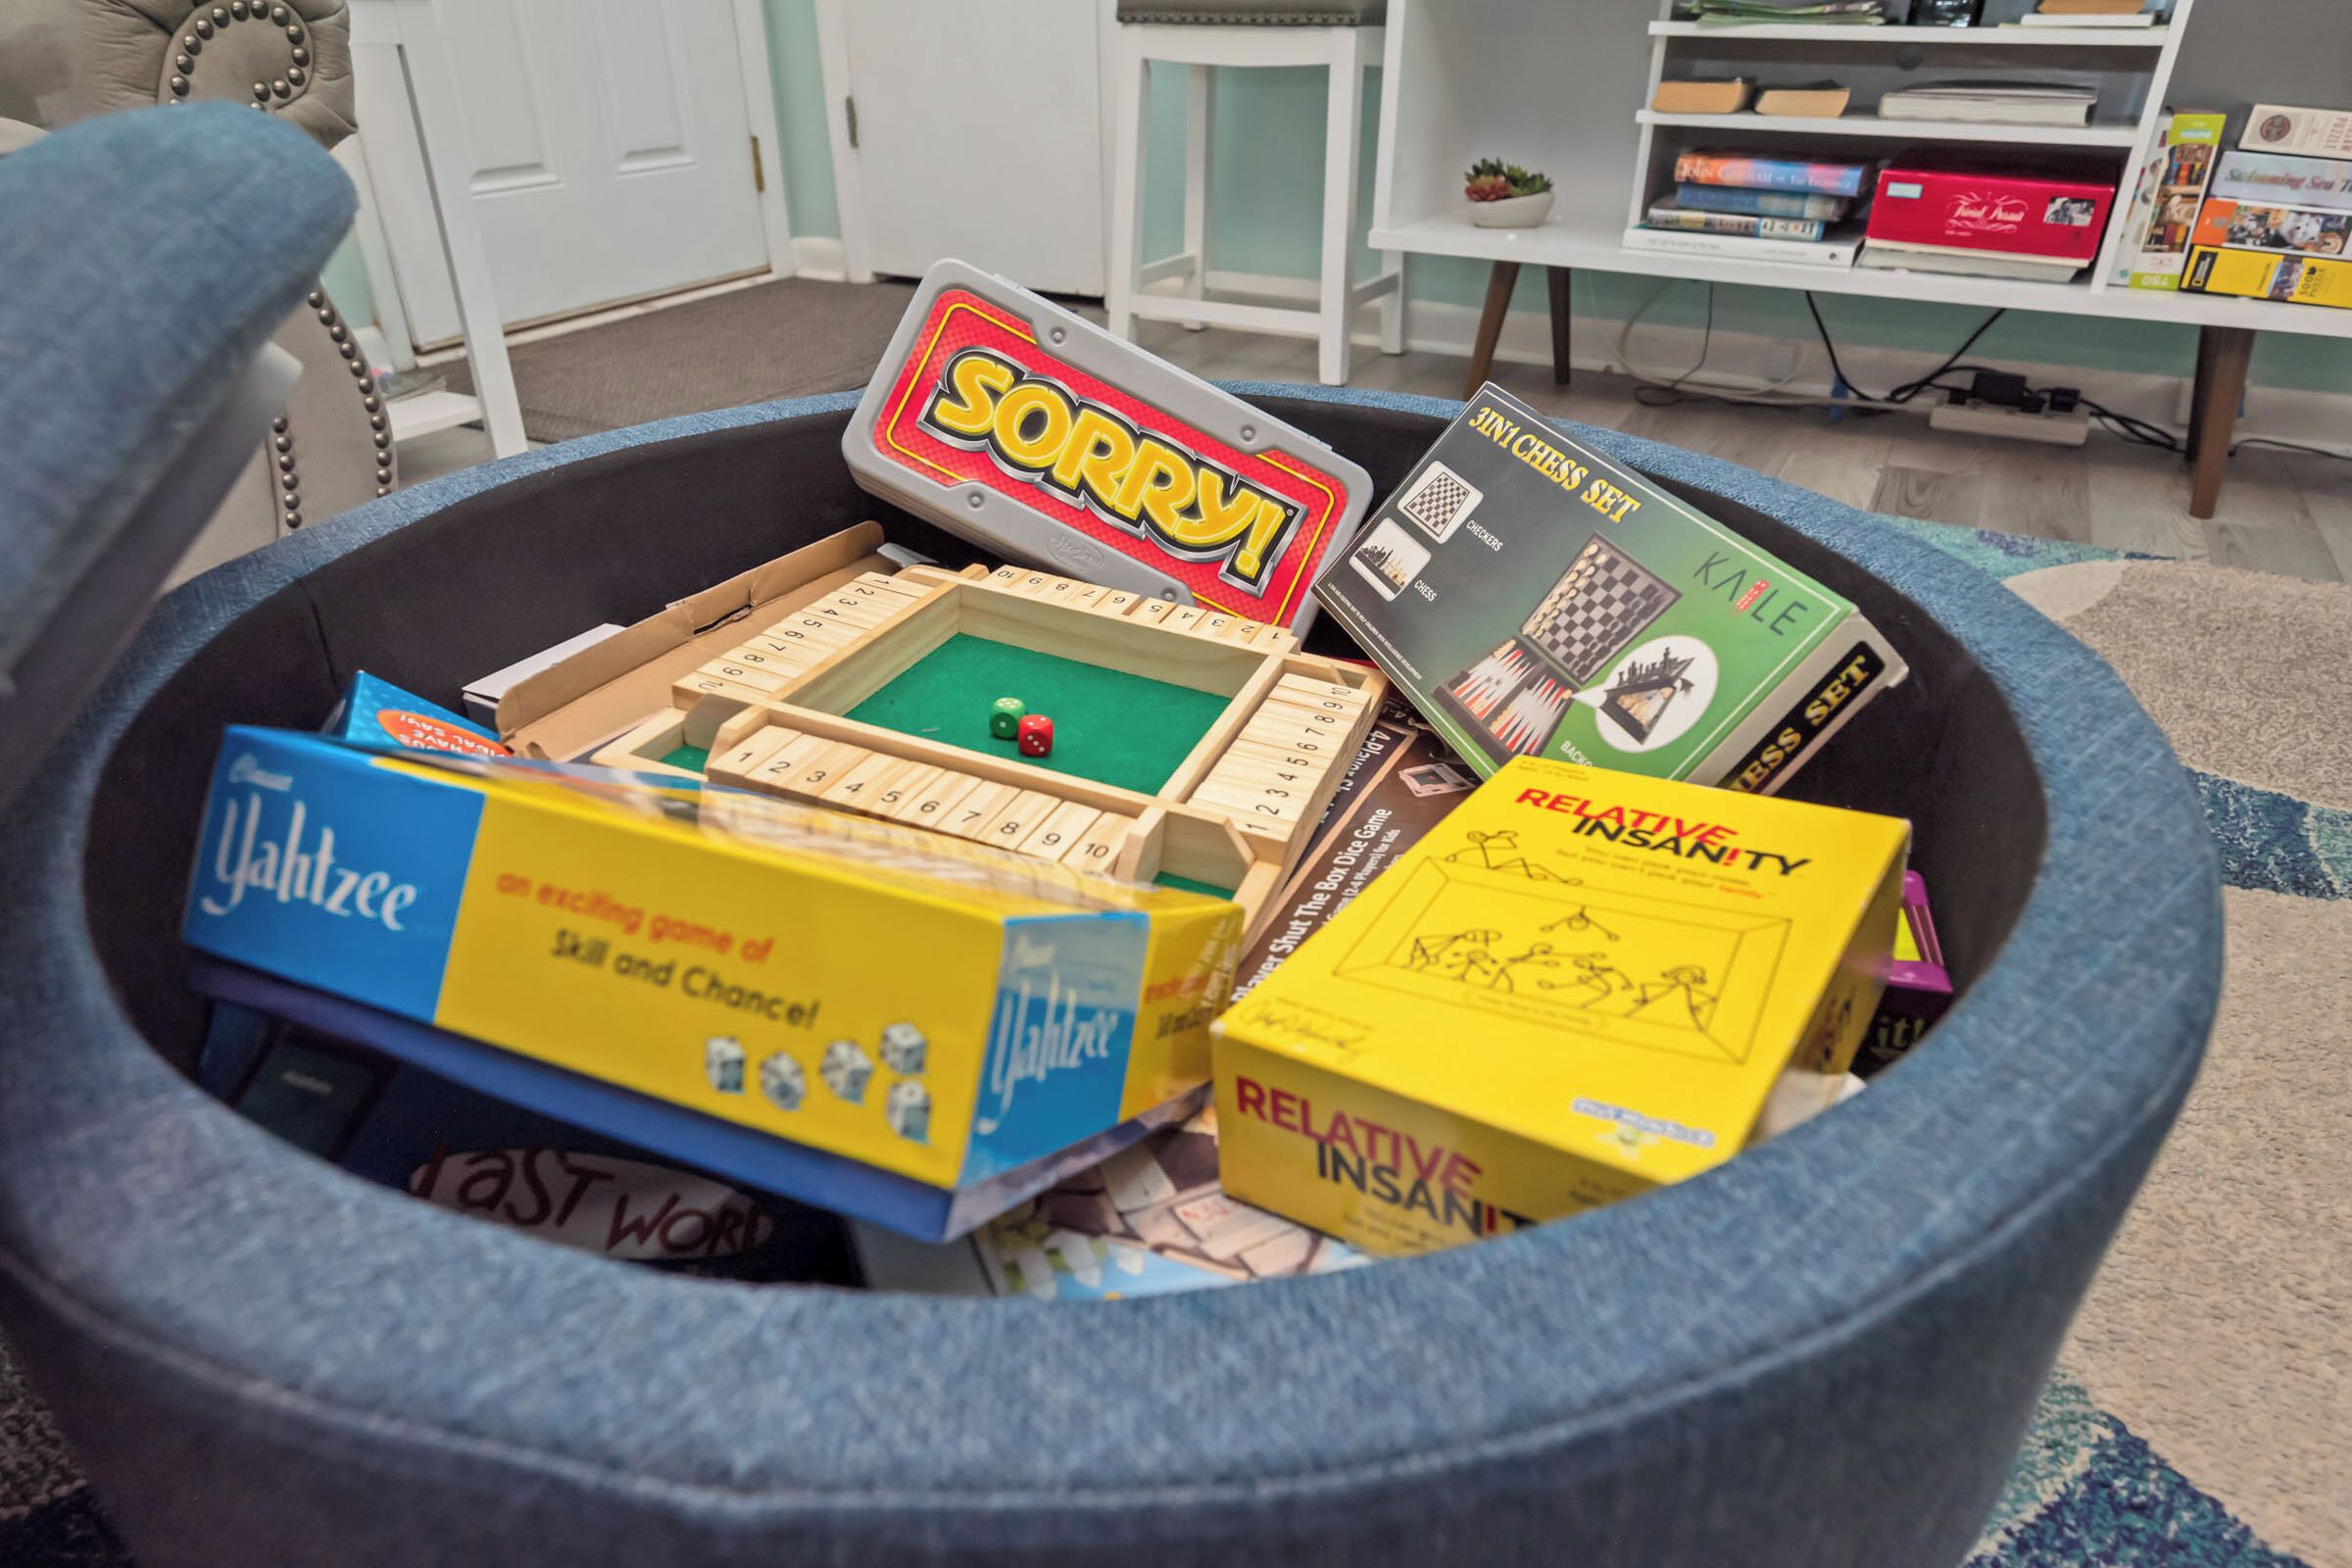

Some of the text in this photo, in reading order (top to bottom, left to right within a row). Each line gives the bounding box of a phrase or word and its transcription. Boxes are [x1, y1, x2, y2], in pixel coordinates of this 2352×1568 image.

[934, 355, 1286, 579] SORRY!
[1510, 431, 1590, 492] CHESS
[1580, 480, 1642, 525] SET
[1465, 518, 1504, 553] CHECKERS
[997, 569, 1015, 579] 10
[1413, 578, 1438, 602] CHESS
[721, 667, 744, 676] 9
[744, 654, 764, 662] 8
[699, 680, 724, 690] 10
[1330, 687, 1351, 697] 10
[1305, 727, 1325, 736] 7
[1314, 714, 1335, 723] 8
[1732, 654, 1869, 792] ESS SET
[1286, 757, 1308, 766] 5
[739, 753, 1109, 858] 1 2 3 4 5 6 7 8 9 10
[1255, 805, 1280, 814] 2
[1265, 789, 1289, 798] 3
[1354, 808, 1394, 847] Game
[1515, 788, 1739, 846] RELATIVE
[1341, 831, 1372, 867] Dice
[1372, 842, 1392, 854] for
[1380, 829, 1401, 843] Kids
[1572, 817, 1811, 875] INSAN!TY
[200, 793, 417, 931] Yahtzee
[1322, 854, 1351, 891] Box
[1294, 883, 1331, 917] The
[496, 871, 777, 965] an exciting game of
[1269, 914, 1312, 955] Shut
[551, 928, 821, 1031] Skill and Chance!
[1236, 1075, 1484, 1199] RELATIVE
[605, 1192, 773, 1254] WORD
